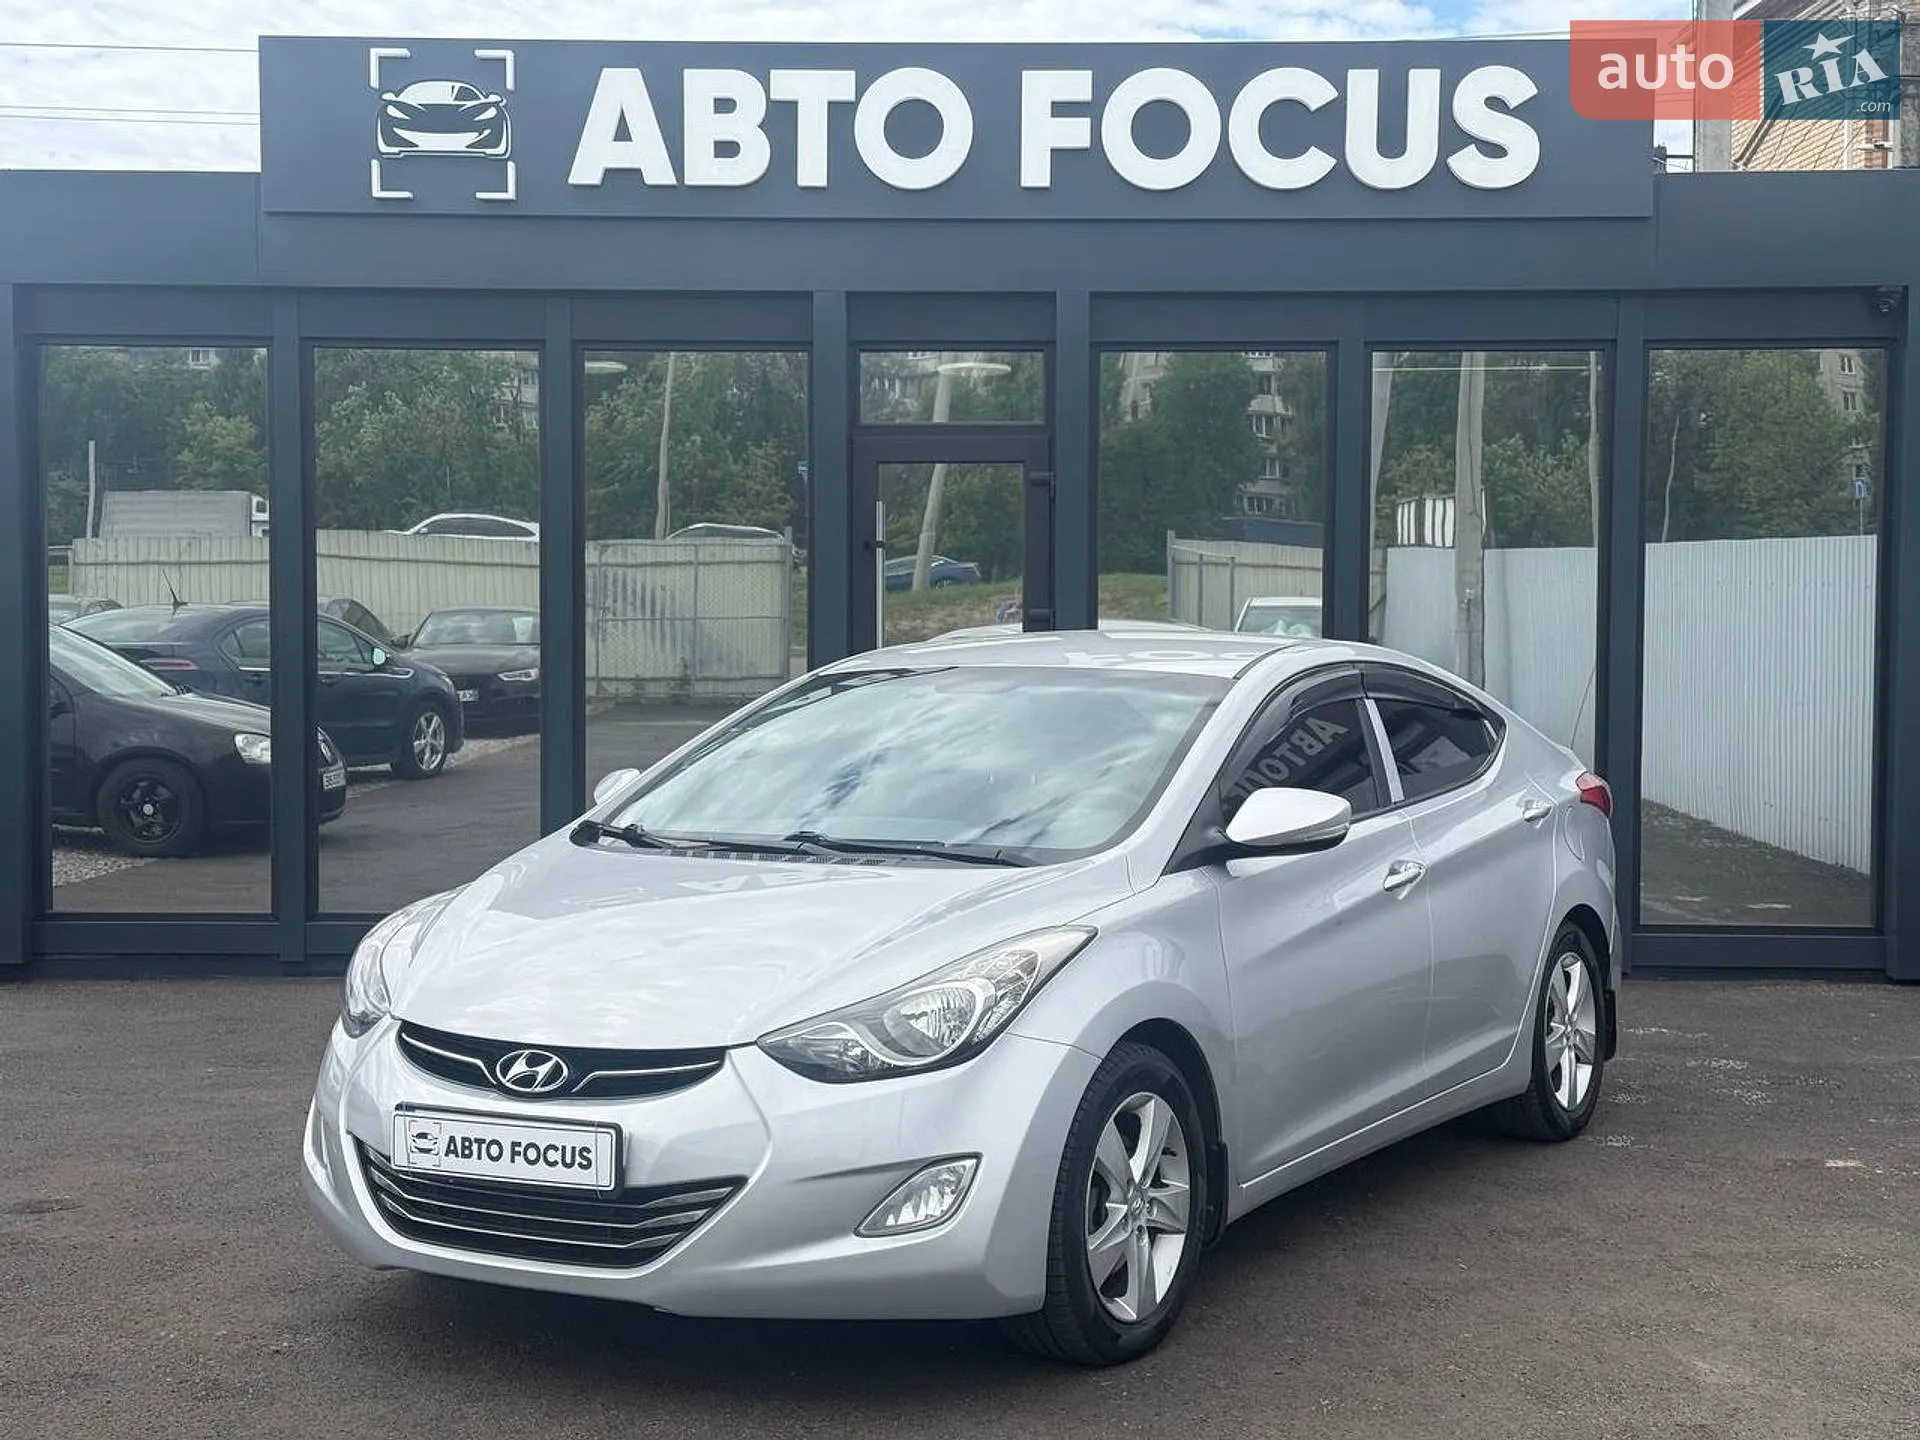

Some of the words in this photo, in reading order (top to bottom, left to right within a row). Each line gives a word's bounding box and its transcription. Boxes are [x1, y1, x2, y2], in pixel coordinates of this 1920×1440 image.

[568, 67, 975, 190] АВТО
[1020, 66, 1541, 190] FOCUS
[445, 1135, 503, 1162] АВТО
[510, 1141, 593, 1170] FOCUS
